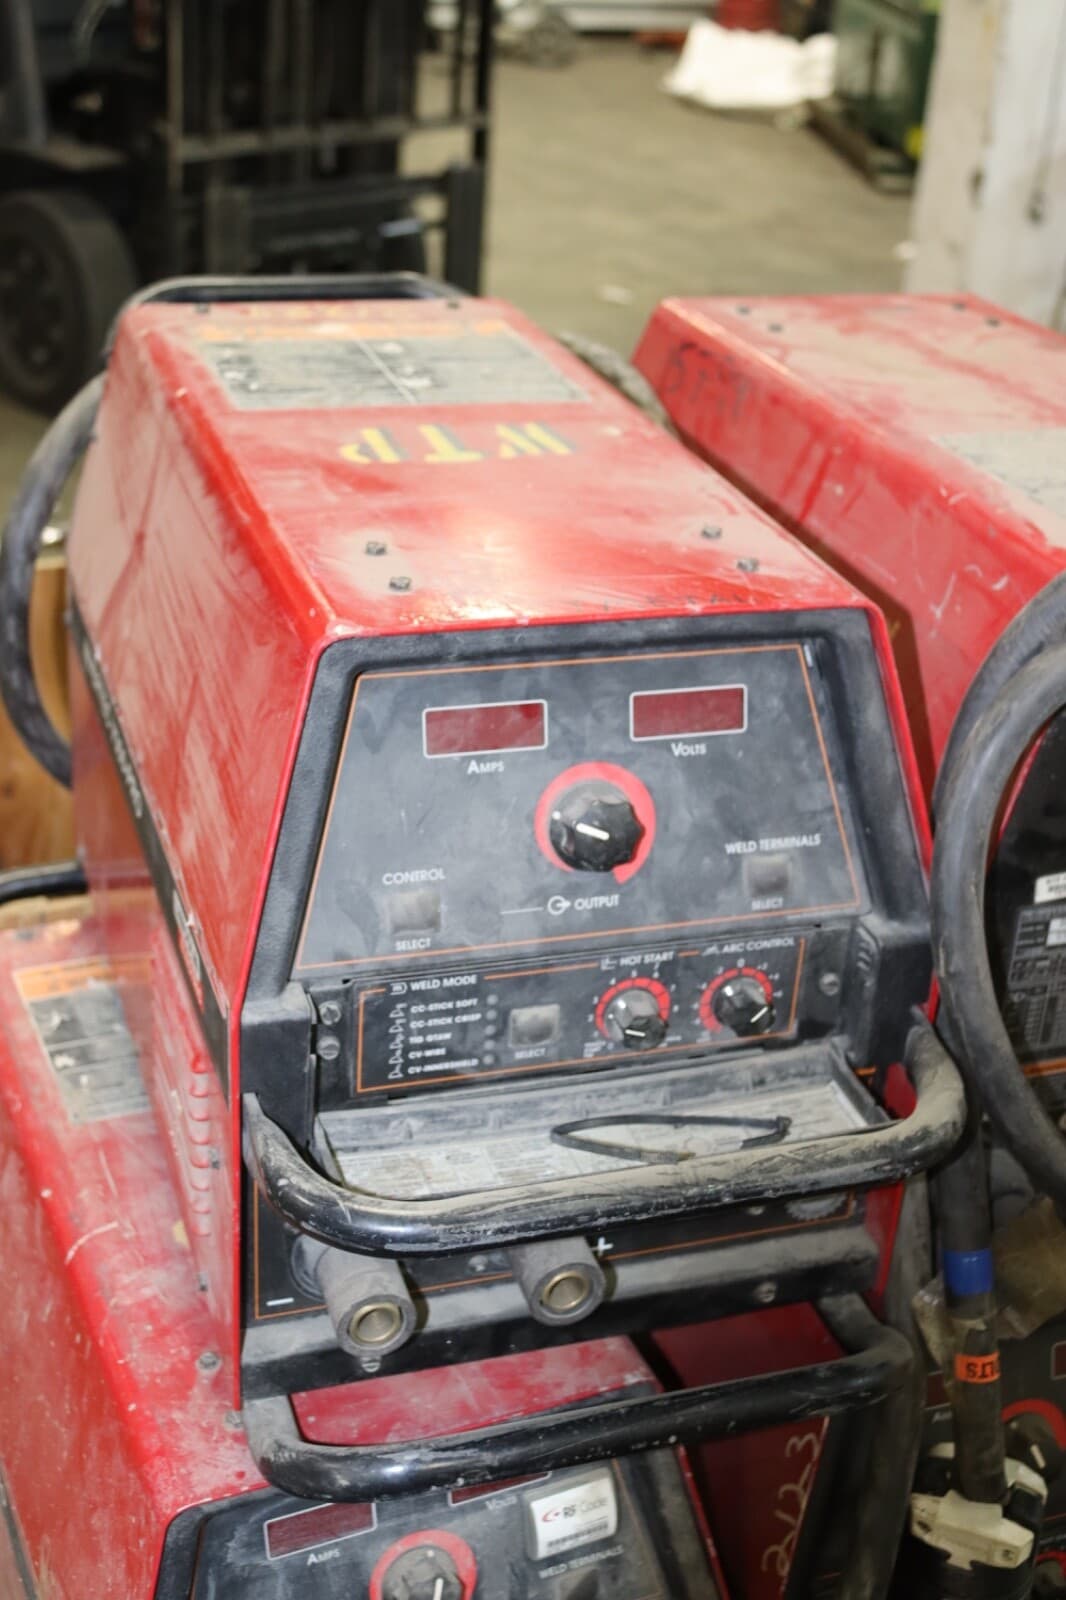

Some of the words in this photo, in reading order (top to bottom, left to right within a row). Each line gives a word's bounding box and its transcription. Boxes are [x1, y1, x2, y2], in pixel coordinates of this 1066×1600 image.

[670, 742, 706, 757] VOLTS
[467, 759, 504, 775] AMPS
[725, 840, 757, 854] WELD
[759, 833, 821, 851] TERMINALS
[382, 868, 446, 886] CONTROL
[574, 894, 620, 911] OUTPUT
[395, 937, 431, 951] SELECT
[722, 942, 745, 953] ARC
[745, 937, 795, 951] CONTROL
[619, 956, 642, 967] HOT
[643, 951, 675, 963] START
[410, 979, 440, 991] WELD
[442, 974, 477, 987] MODE
[515, 1048, 546, 1060] SELECT
[307, 1548, 340, 1566] AMPS
